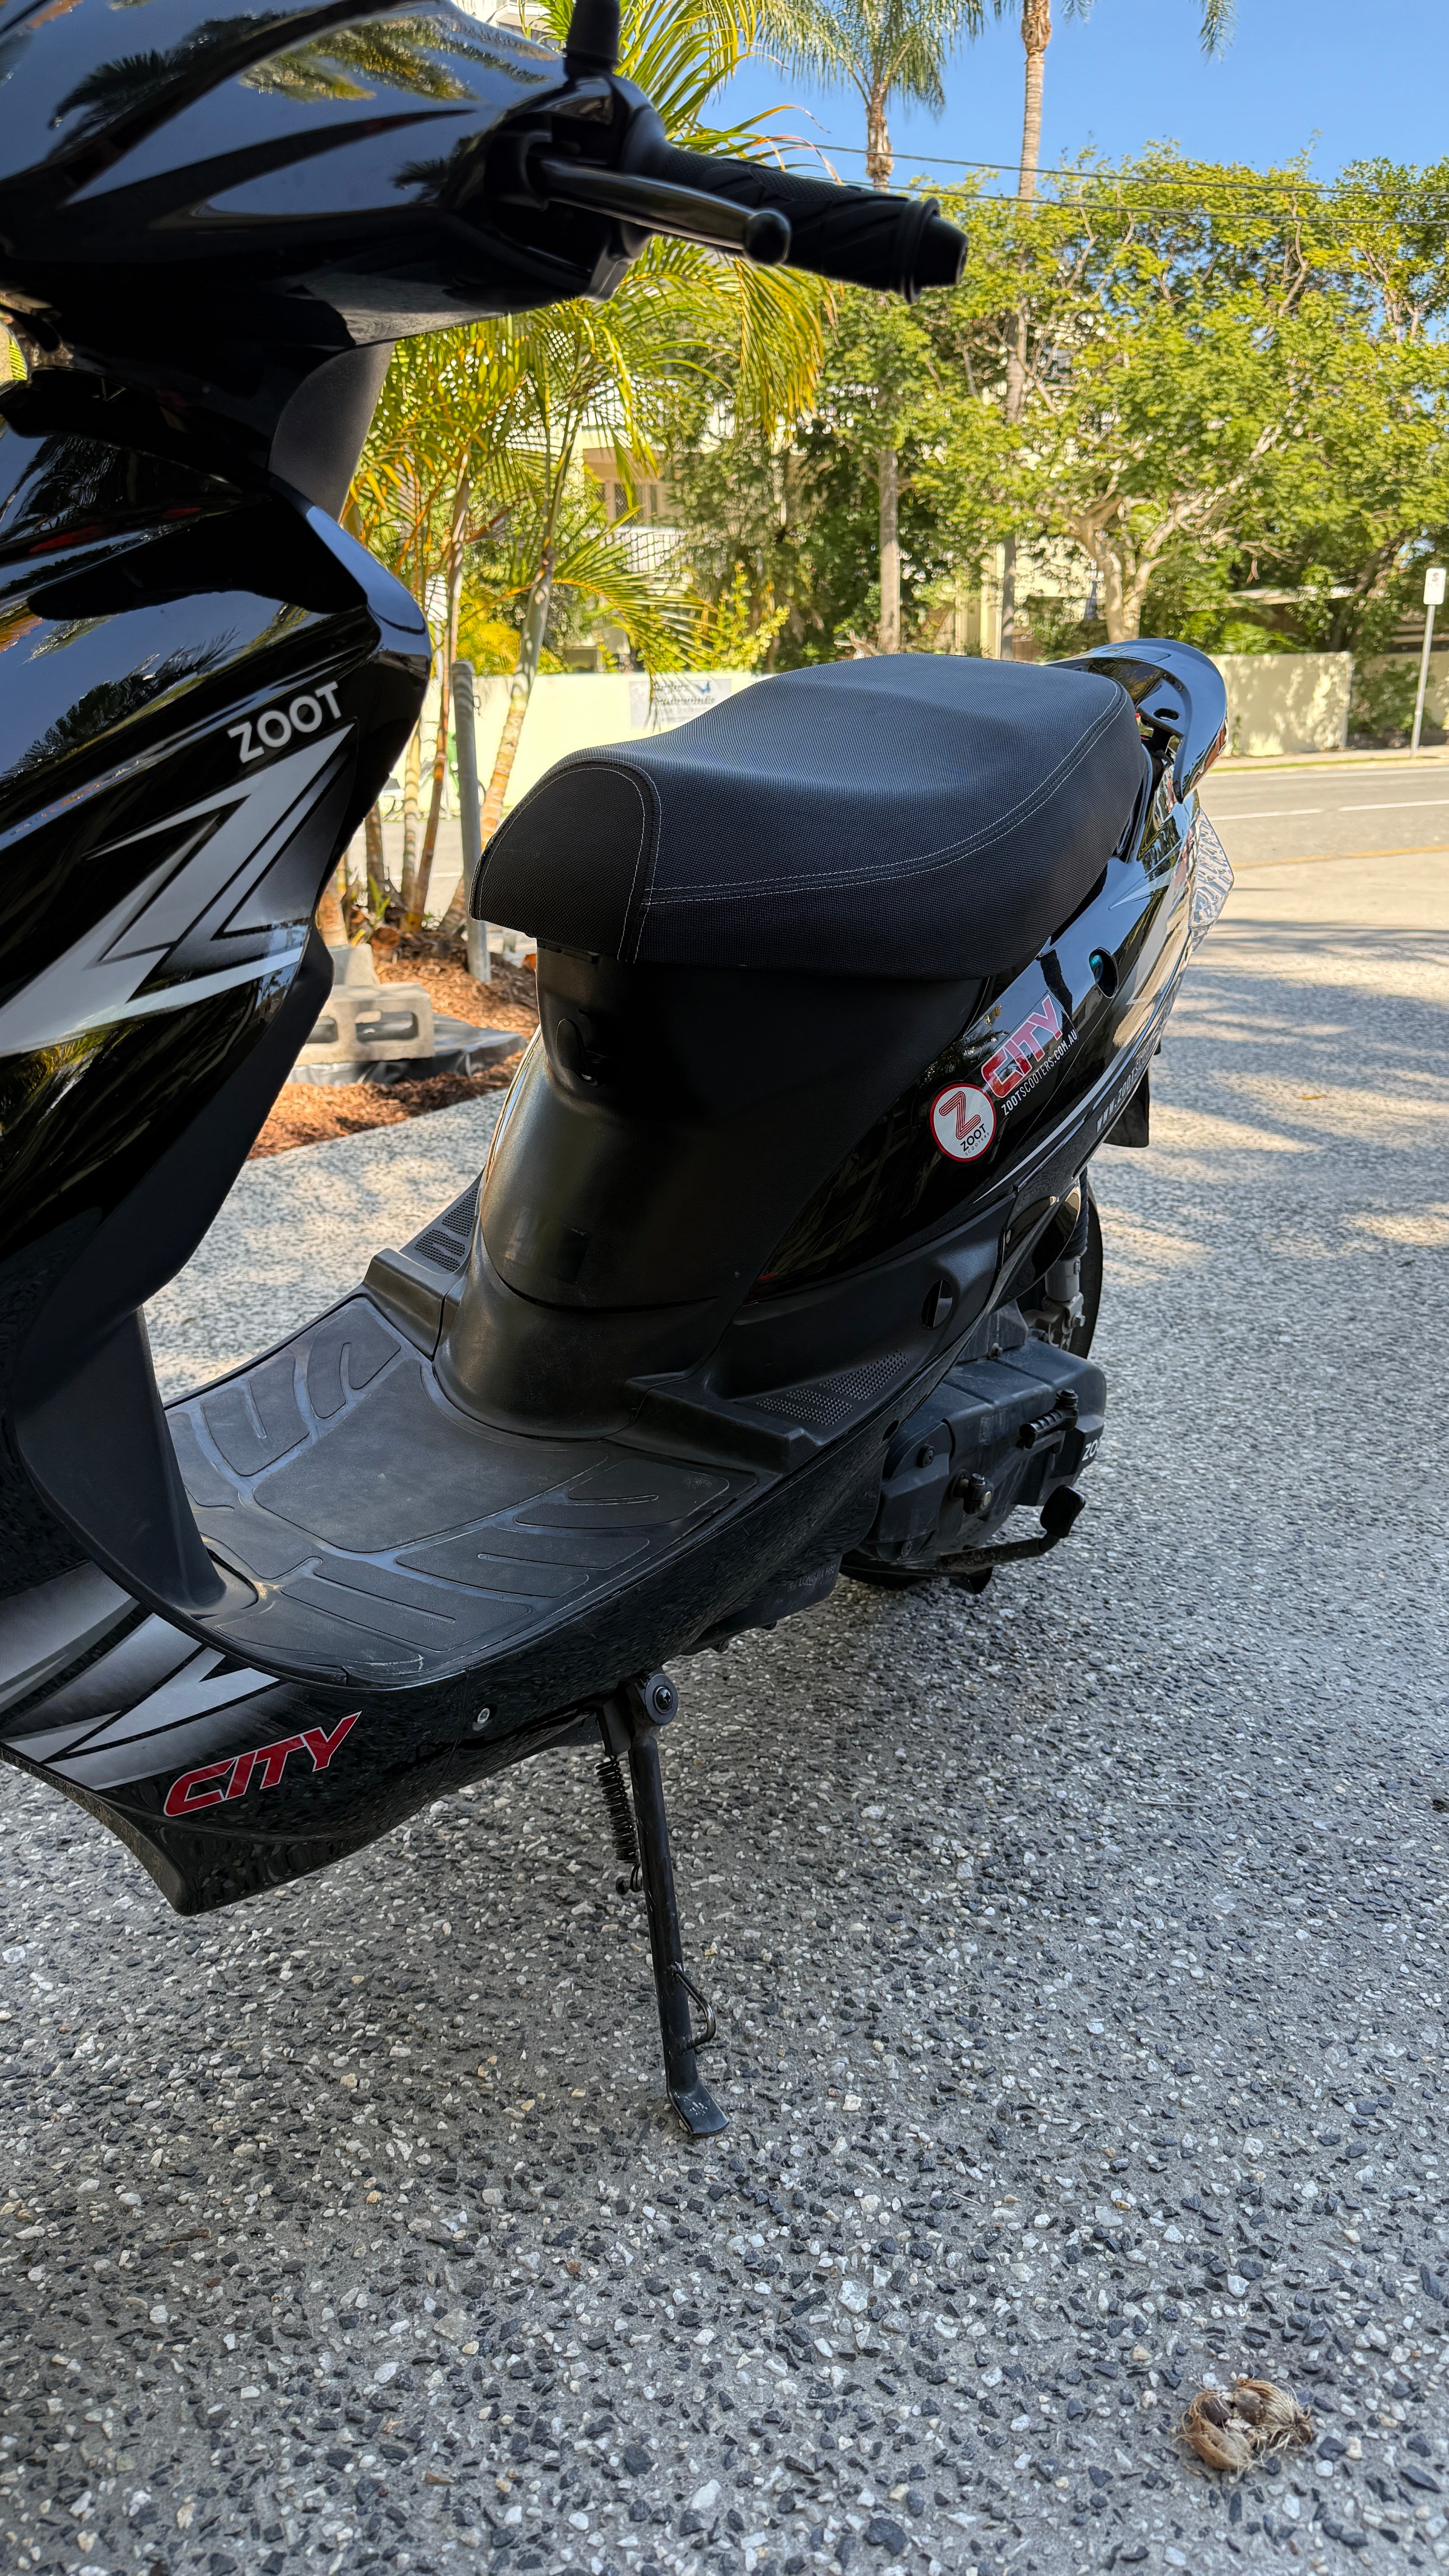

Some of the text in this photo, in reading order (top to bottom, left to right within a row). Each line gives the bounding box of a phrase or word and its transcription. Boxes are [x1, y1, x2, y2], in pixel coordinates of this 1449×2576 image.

[227, 681, 341, 764] ZOOT
[981, 994, 1062, 1098] CITY
[1001, 1029, 1077, 1116] ZOOTSCOOTERS.COM.AU
[960, 1123, 986, 1151] ZOOT
[965, 1132, 990, 1156] SCOOTERS
[163, 1711, 362, 1817] CITY
